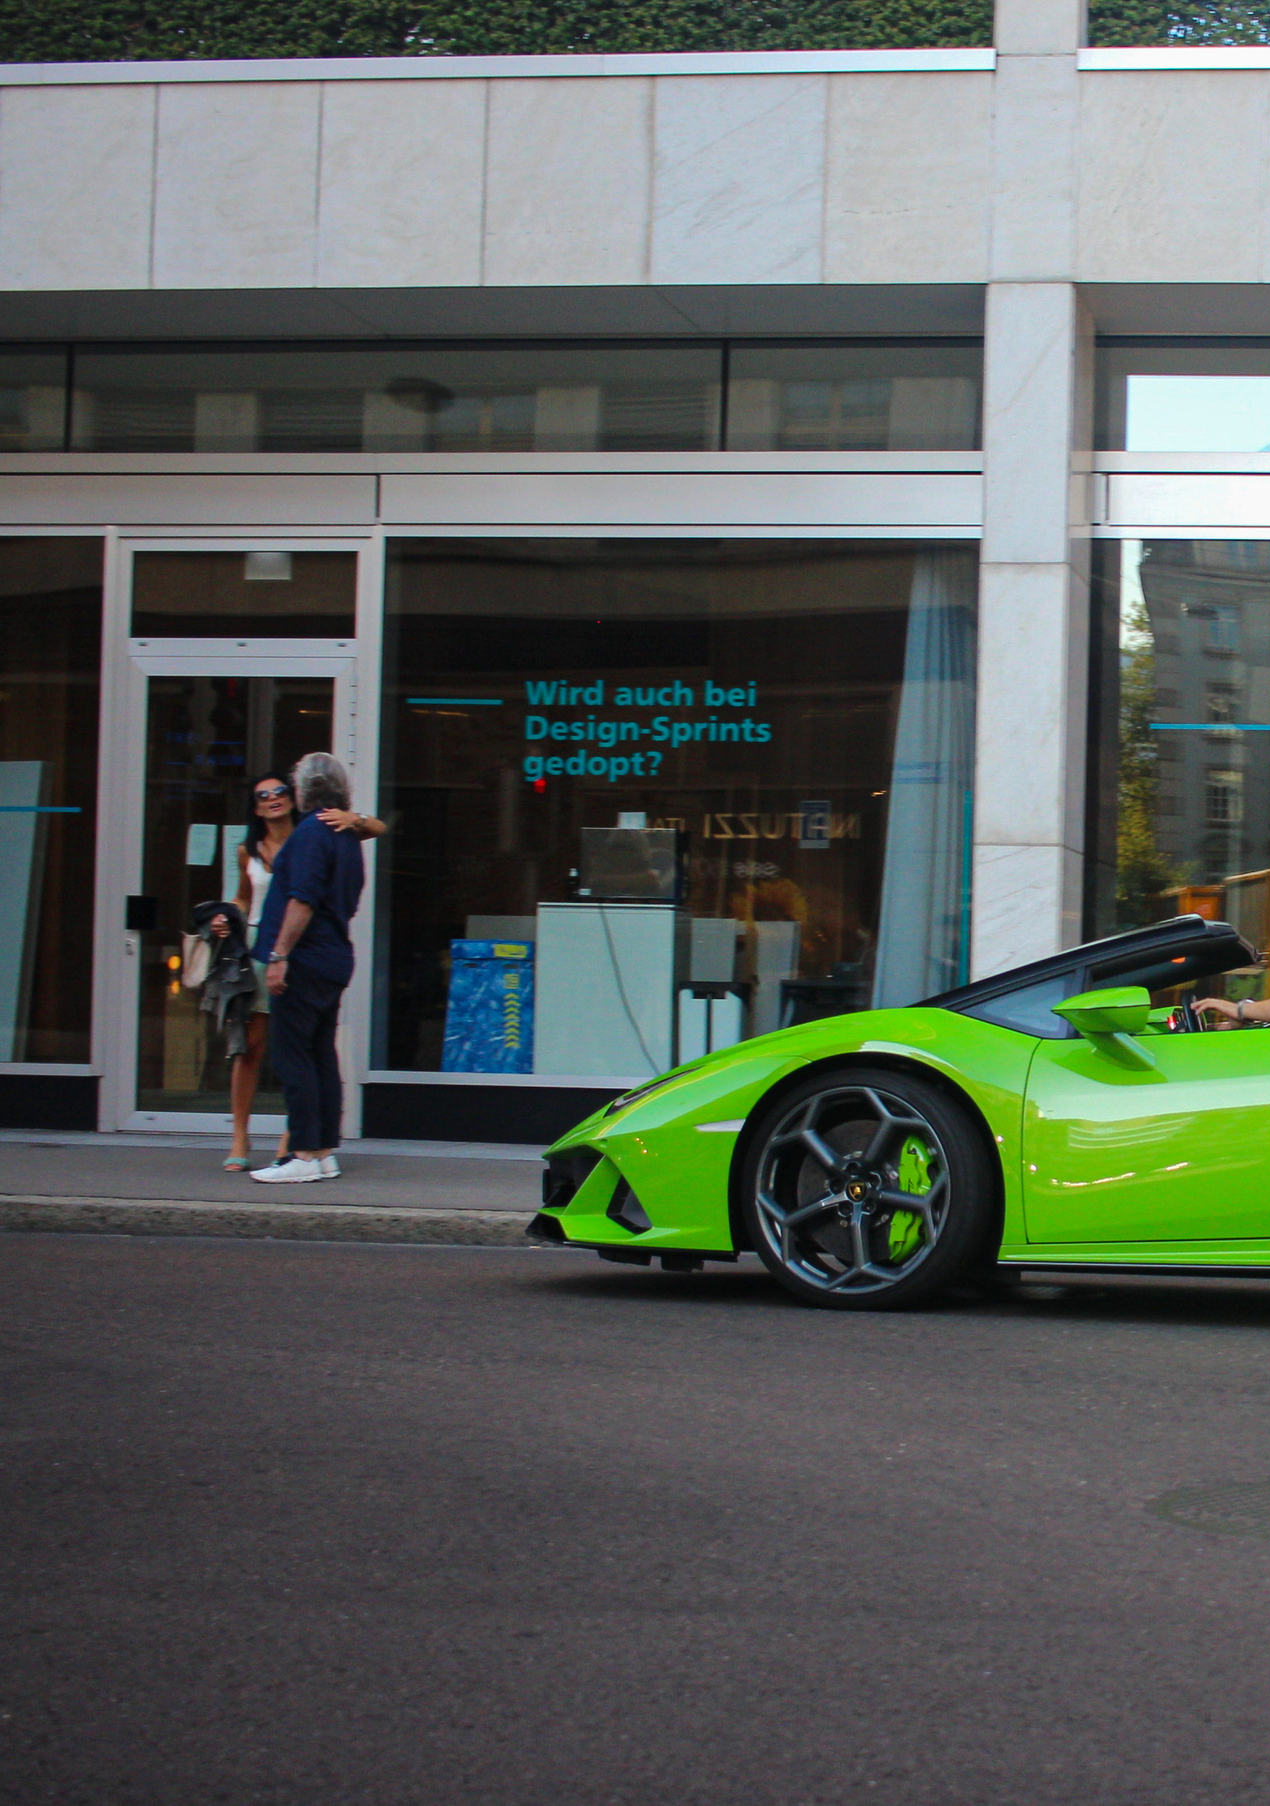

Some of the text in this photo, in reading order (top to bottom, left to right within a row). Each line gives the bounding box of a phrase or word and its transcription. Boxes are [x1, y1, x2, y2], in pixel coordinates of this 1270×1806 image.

[525, 680, 757, 706] Wird auch bei
[525, 715, 772, 748] Design-Sprints
[523, 749, 663, 782] gedopt?
